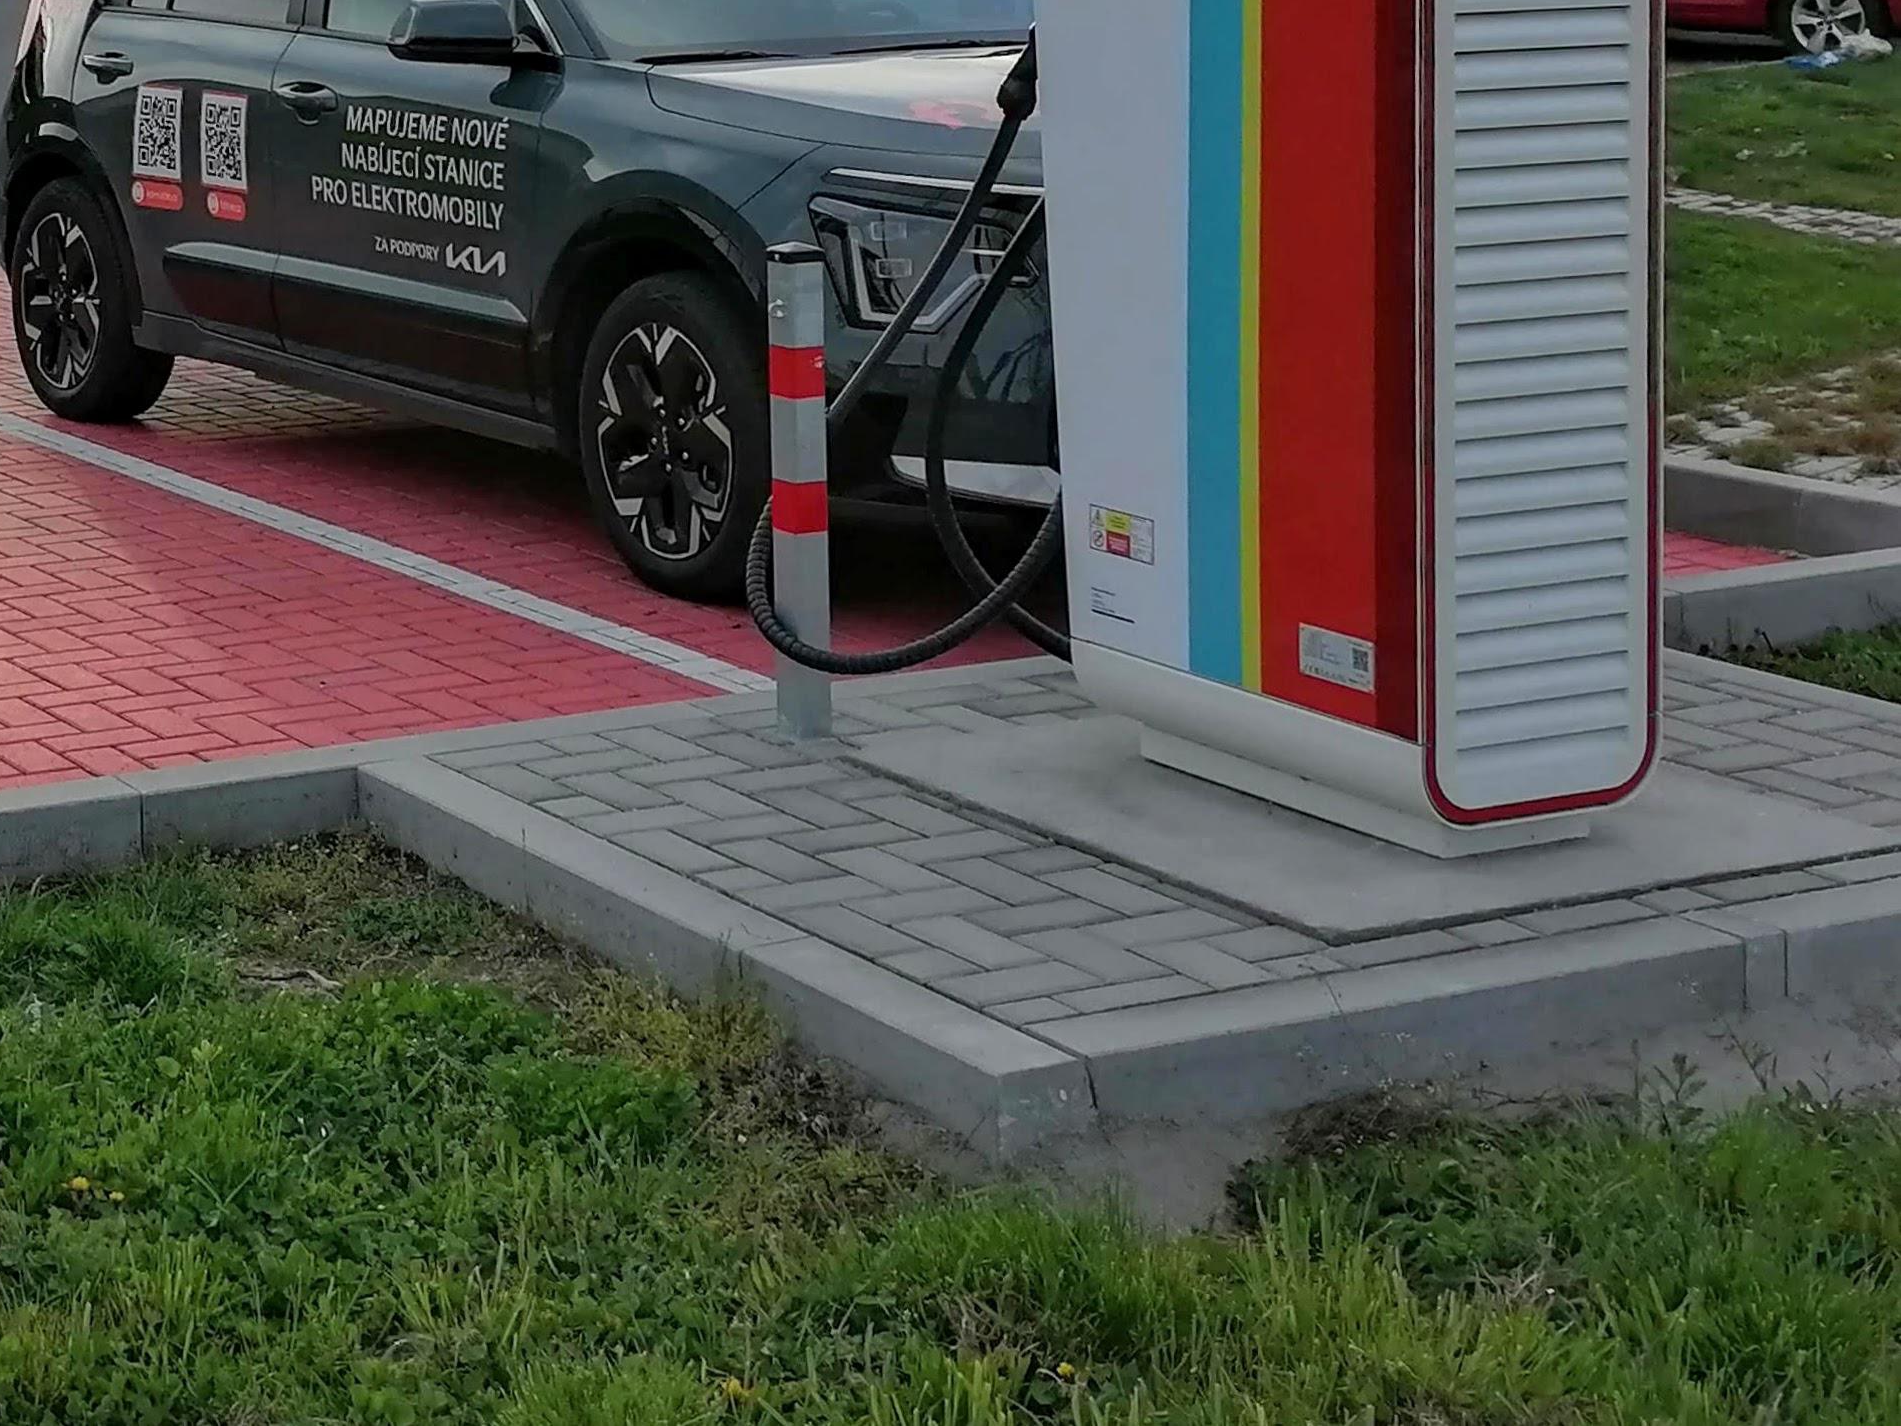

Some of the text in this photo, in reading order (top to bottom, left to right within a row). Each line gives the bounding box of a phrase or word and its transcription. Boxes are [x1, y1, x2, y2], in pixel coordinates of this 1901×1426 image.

[346, 105, 509, 150] MAPUJEME NOVÉ
[342, 142, 504, 191] NABÍJECÍ STANICE
[312, 176, 504, 230] PRO ELEKTROMOBILY
[374, 236, 439, 261] ZA PODPORY
